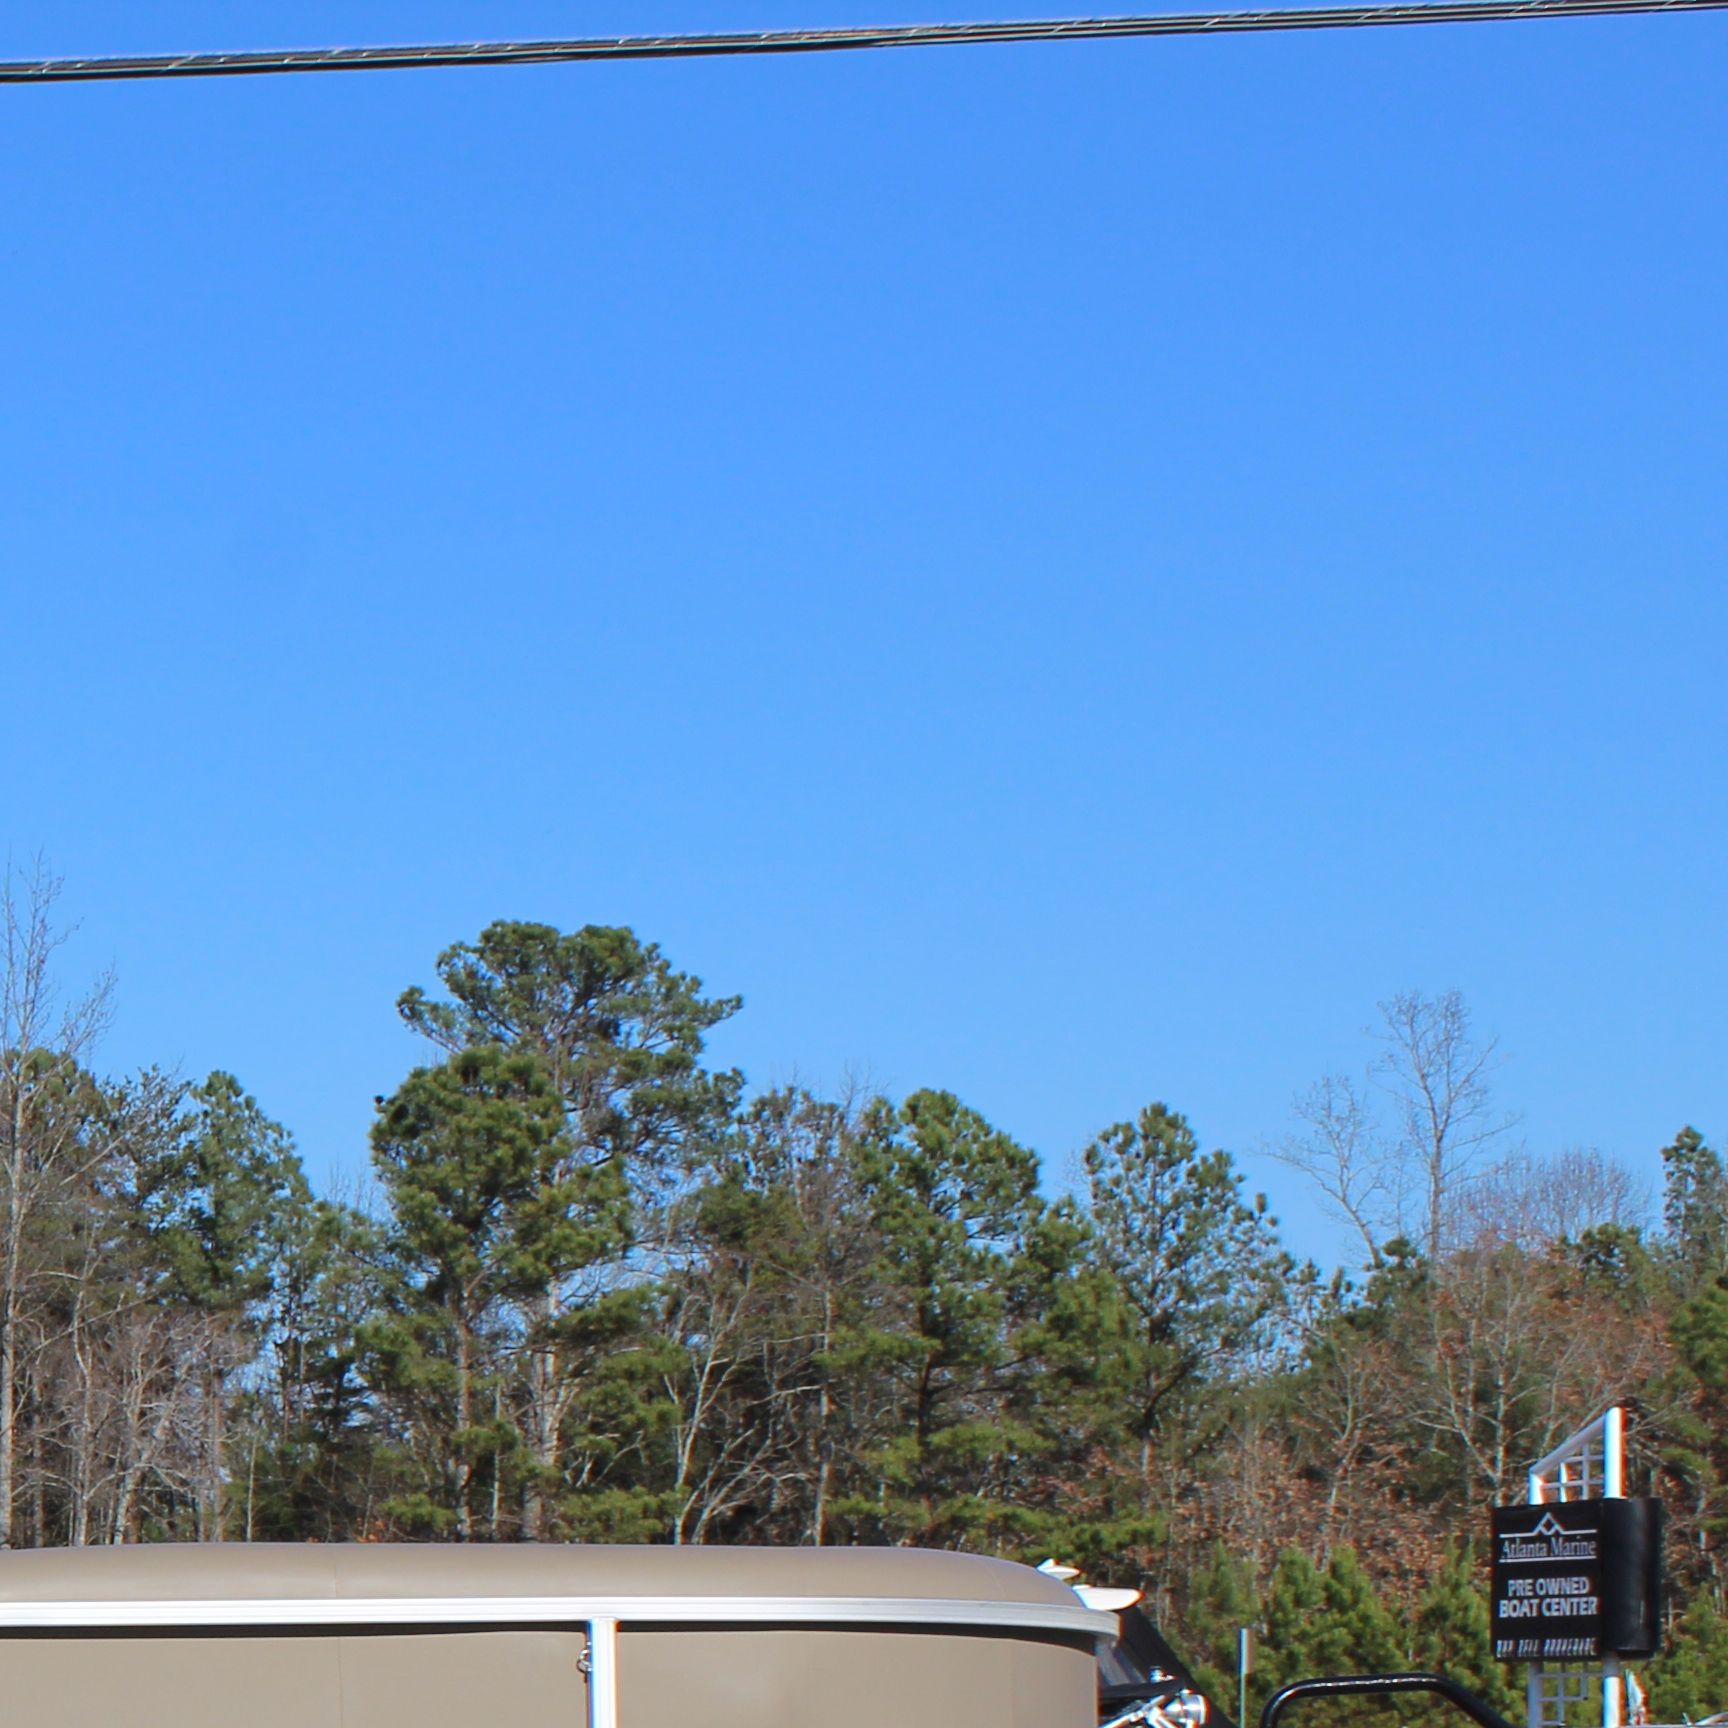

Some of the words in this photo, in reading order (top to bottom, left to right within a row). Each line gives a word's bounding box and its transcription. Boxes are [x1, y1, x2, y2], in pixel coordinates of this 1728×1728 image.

[1502, 1537, 1548, 1558] Atlanta
[1550, 1535, 1597, 1556] Marine
[1507, 1579, 1534, 1597] PRE
[1535, 1576, 1590, 1596] OWNED
[1499, 1599, 1540, 1618] BOAT
[1541, 1596, 1599, 1617] CENTER
